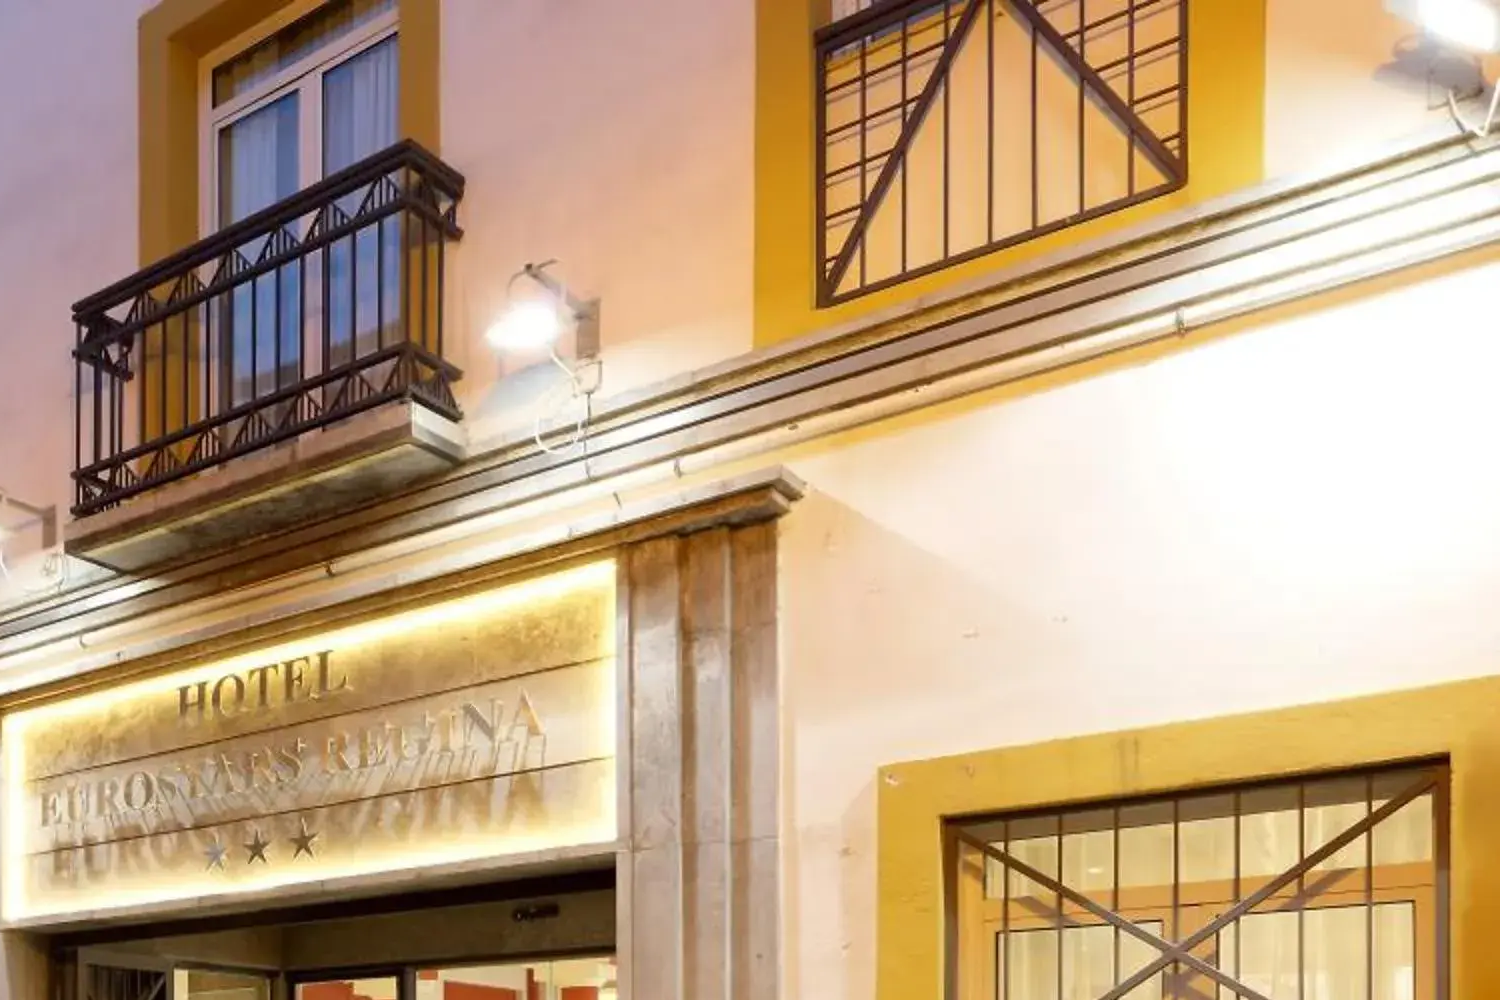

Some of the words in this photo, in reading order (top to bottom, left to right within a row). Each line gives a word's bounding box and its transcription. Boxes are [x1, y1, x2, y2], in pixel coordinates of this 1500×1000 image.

[177, 650, 353, 716] HOTEL
[41, 738, 306, 826] EUROSTARS
[320, 686, 545, 773] REGINA
